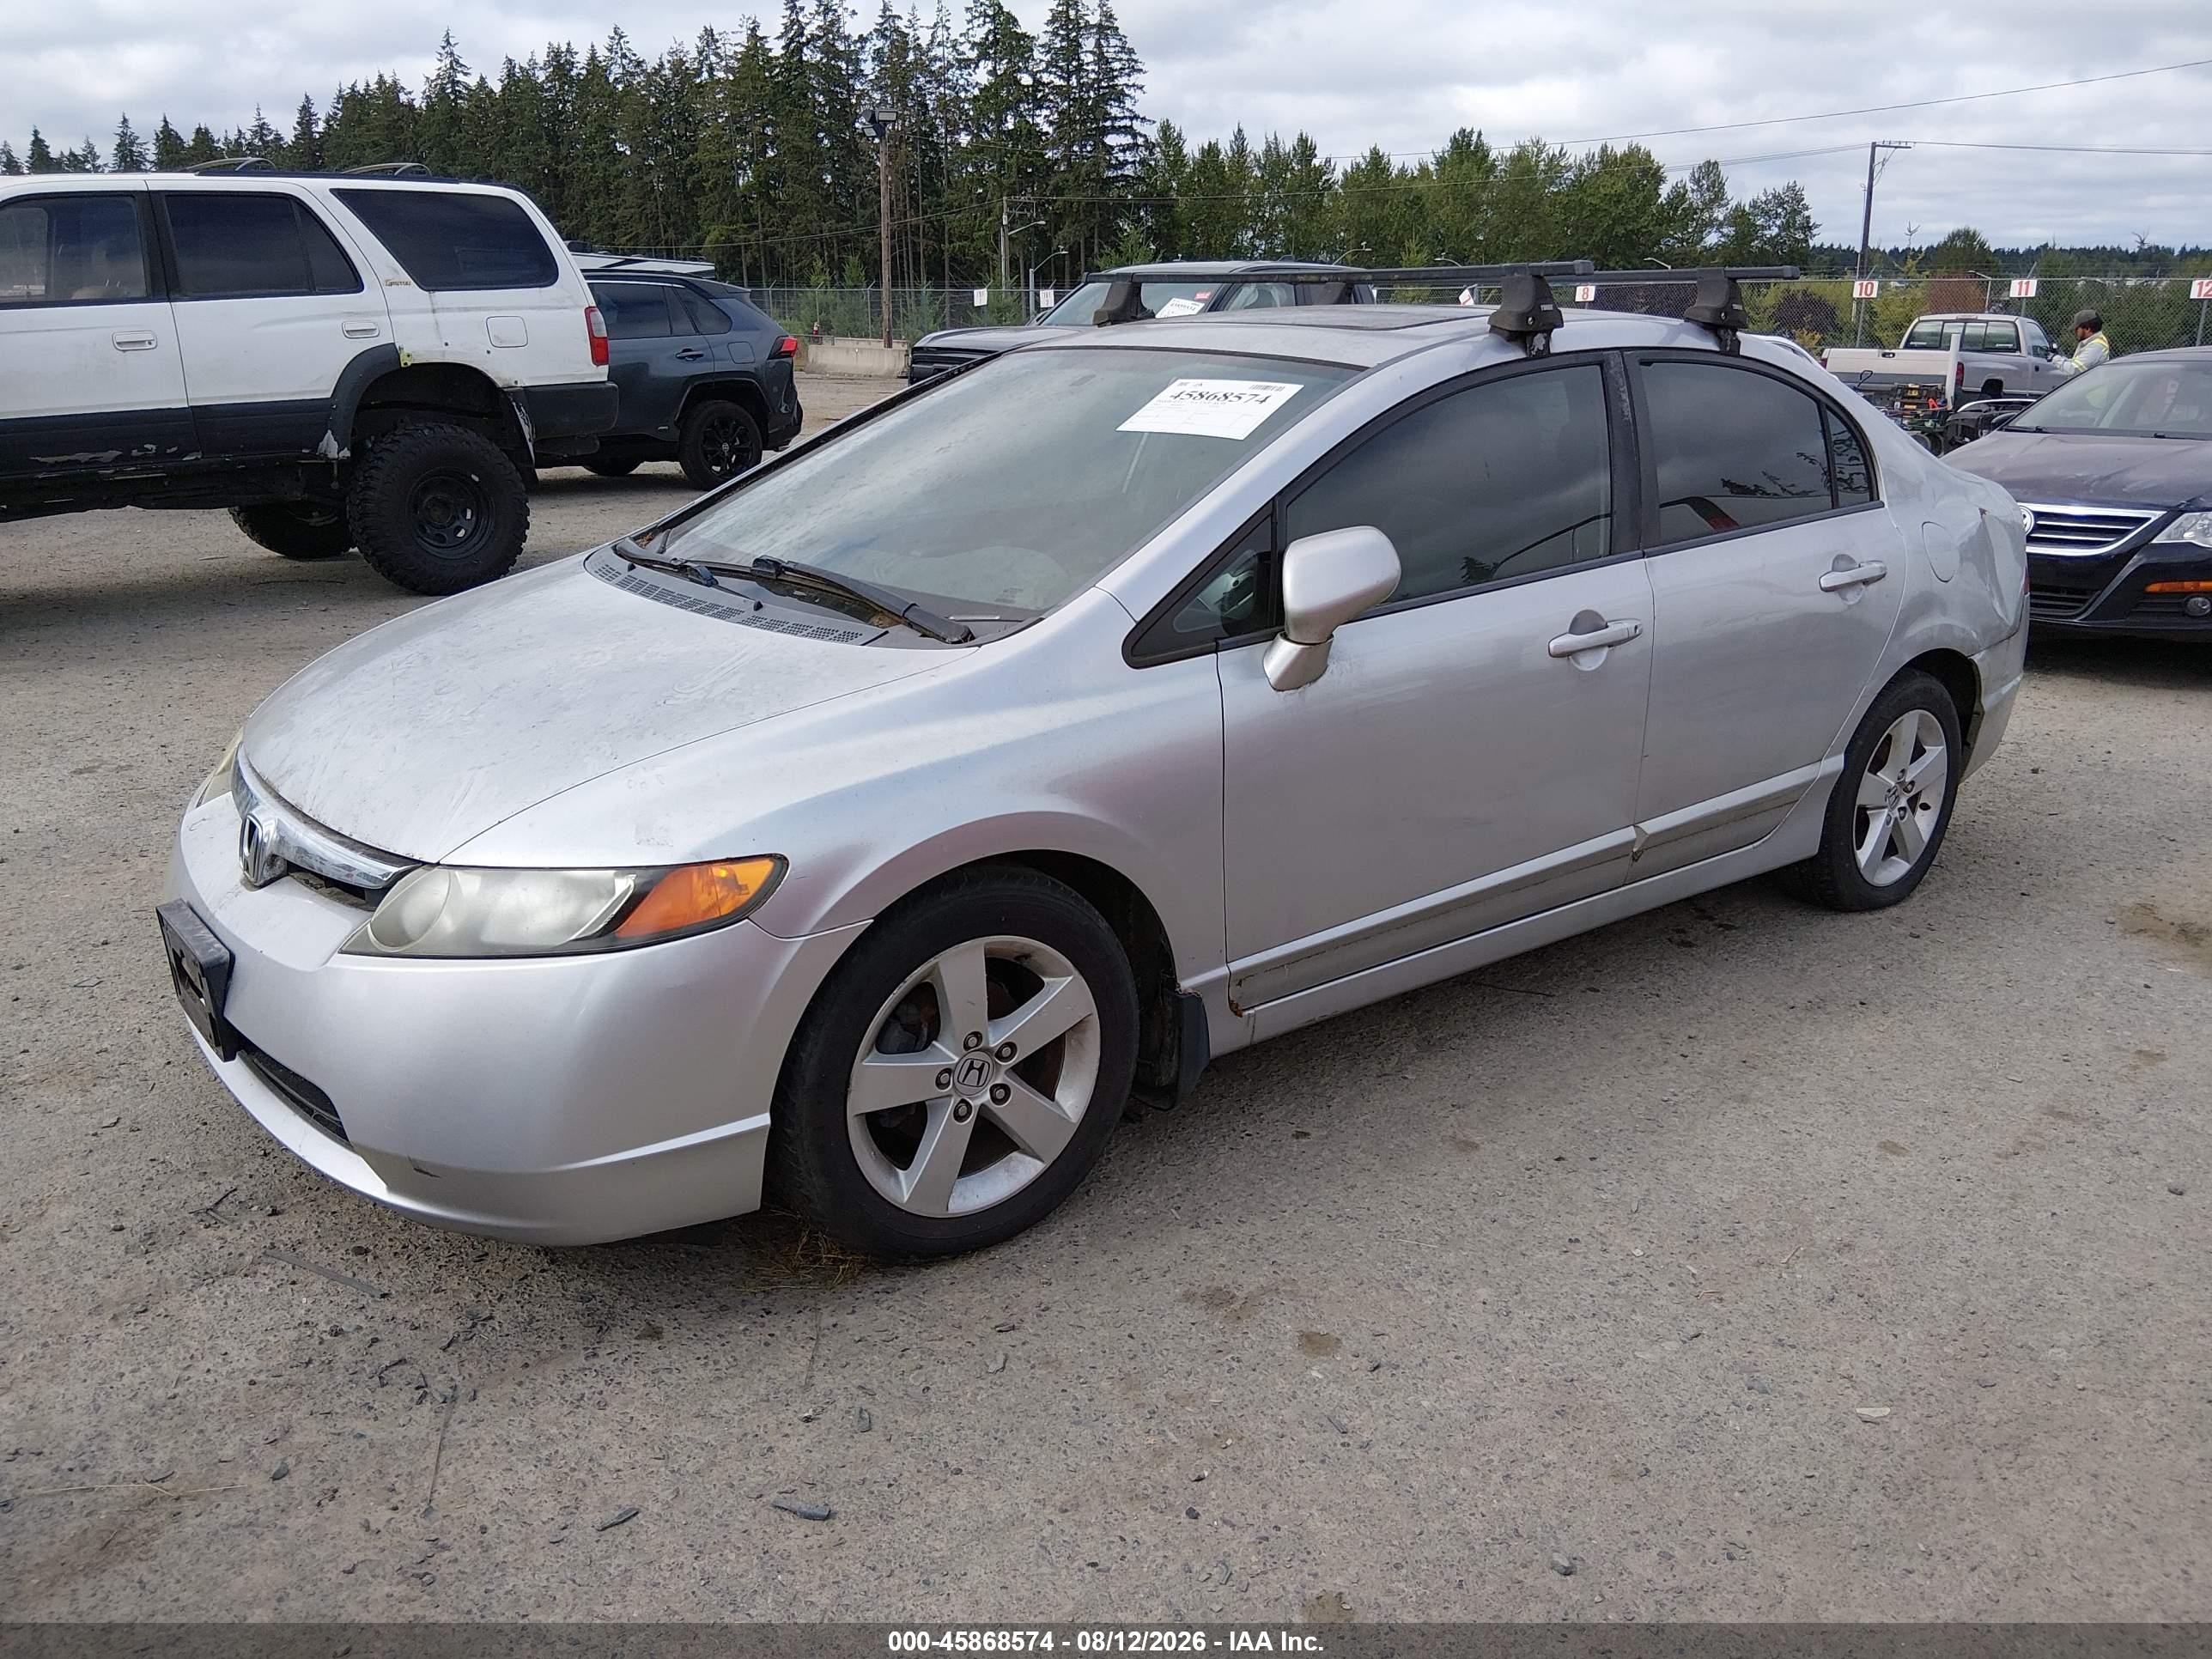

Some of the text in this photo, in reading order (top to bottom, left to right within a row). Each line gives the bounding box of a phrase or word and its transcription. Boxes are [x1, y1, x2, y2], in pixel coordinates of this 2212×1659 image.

[1582, 287, 1589, 301] 8
[1858, 282, 1875, 297] 10
[2018, 280, 2031, 296] 11
[1170, 390, 1272, 404] 45868574
